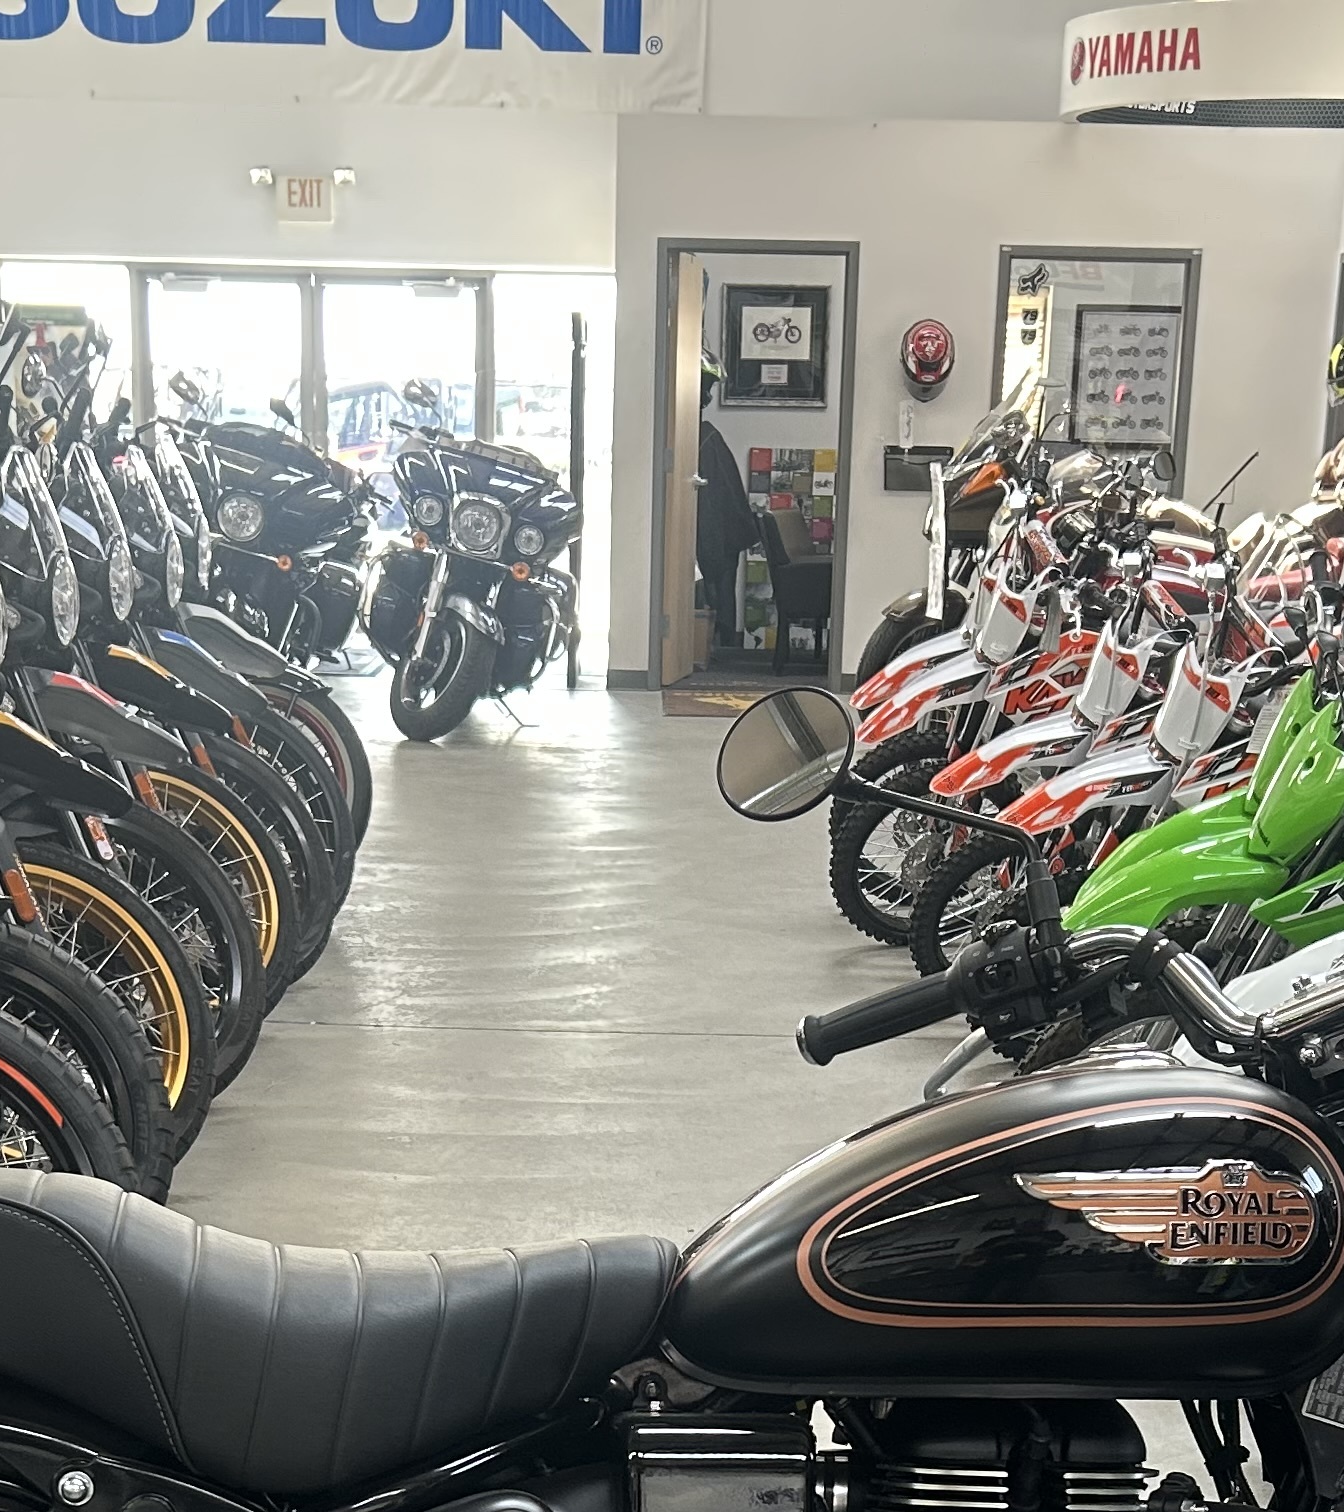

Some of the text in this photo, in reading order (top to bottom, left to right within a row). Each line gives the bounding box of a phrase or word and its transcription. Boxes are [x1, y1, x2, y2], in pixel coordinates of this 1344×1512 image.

[1088, 27, 1201, 79] YAMAHA
[287, 178, 323, 208] EXIT
[1179, 1186, 1281, 1219] ROYAL
[1169, 1220, 1293, 1251] ENFIELD
